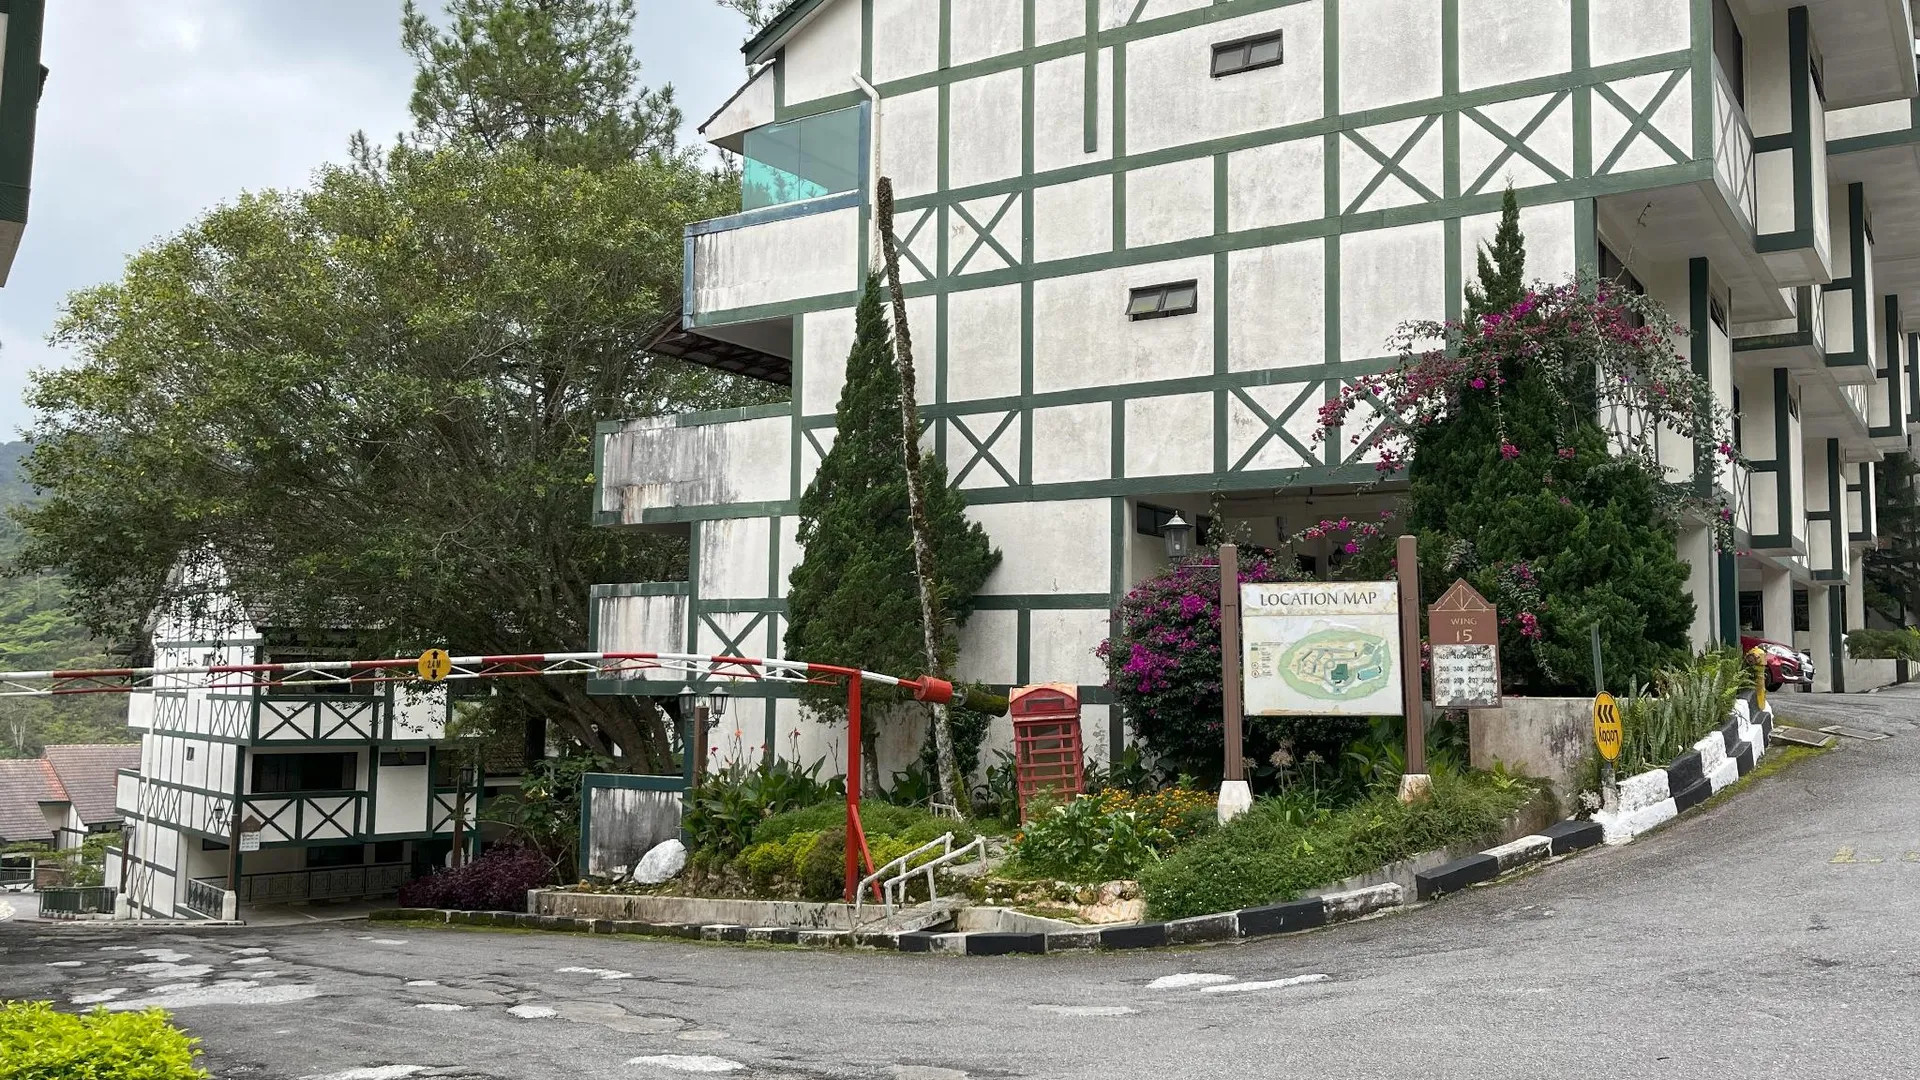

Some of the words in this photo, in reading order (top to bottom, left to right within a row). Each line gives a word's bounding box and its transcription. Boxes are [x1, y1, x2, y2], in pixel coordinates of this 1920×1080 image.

[1260, 592, 1338, 606] LOCATION
[1343, 591, 1377, 605] MAP
[1450, 617, 1477, 625] WING
[1456, 629, 1473, 642] 15
[1599, 727, 1619, 746] Lobby
